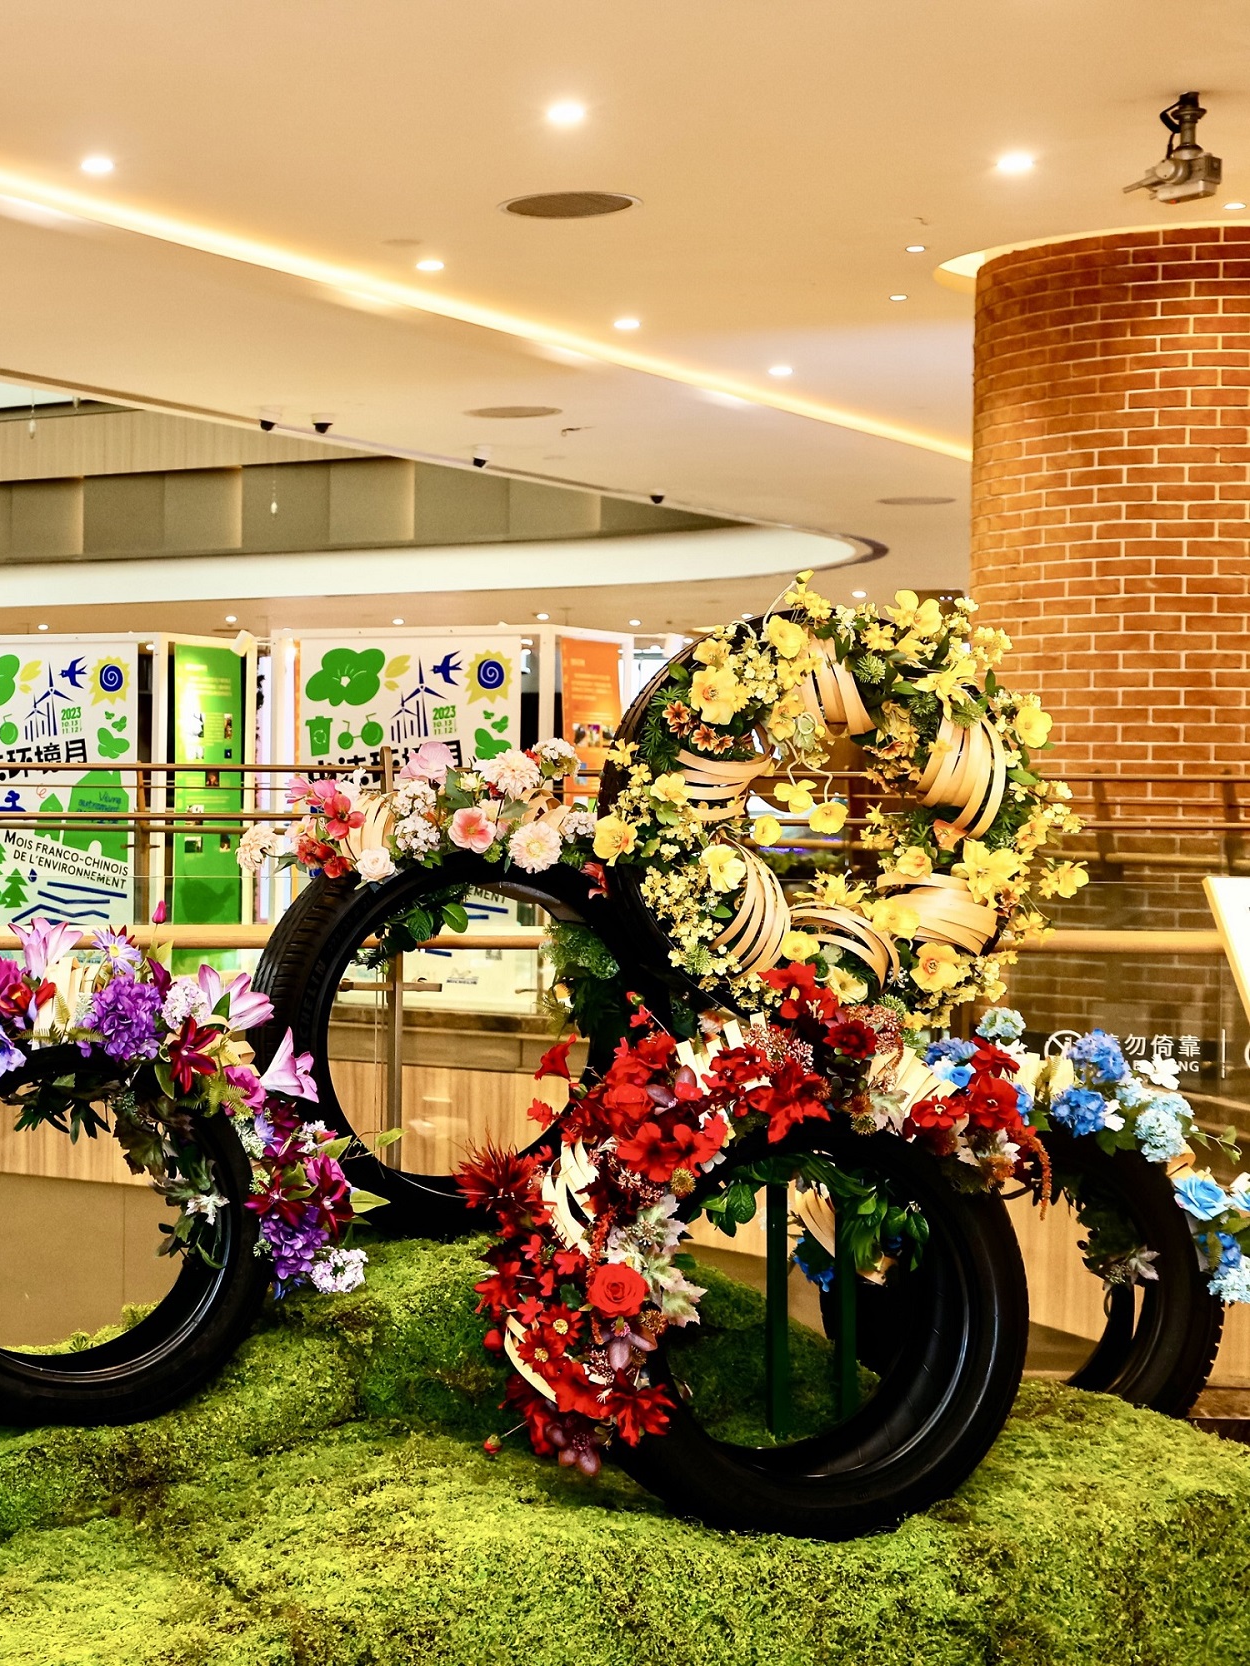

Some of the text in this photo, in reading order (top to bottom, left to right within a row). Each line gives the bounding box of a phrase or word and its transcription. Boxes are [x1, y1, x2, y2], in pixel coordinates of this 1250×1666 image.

[61, 706, 81, 720] 2023
[432, 705, 456, 720] 2023
[13, 849, 127, 889] DE L'ENVIRONNEMENT
[35, 842, 129, 876] FRANCO-CHINOIS
[1110, 1034, 1201, 1058] 勿倚靠
